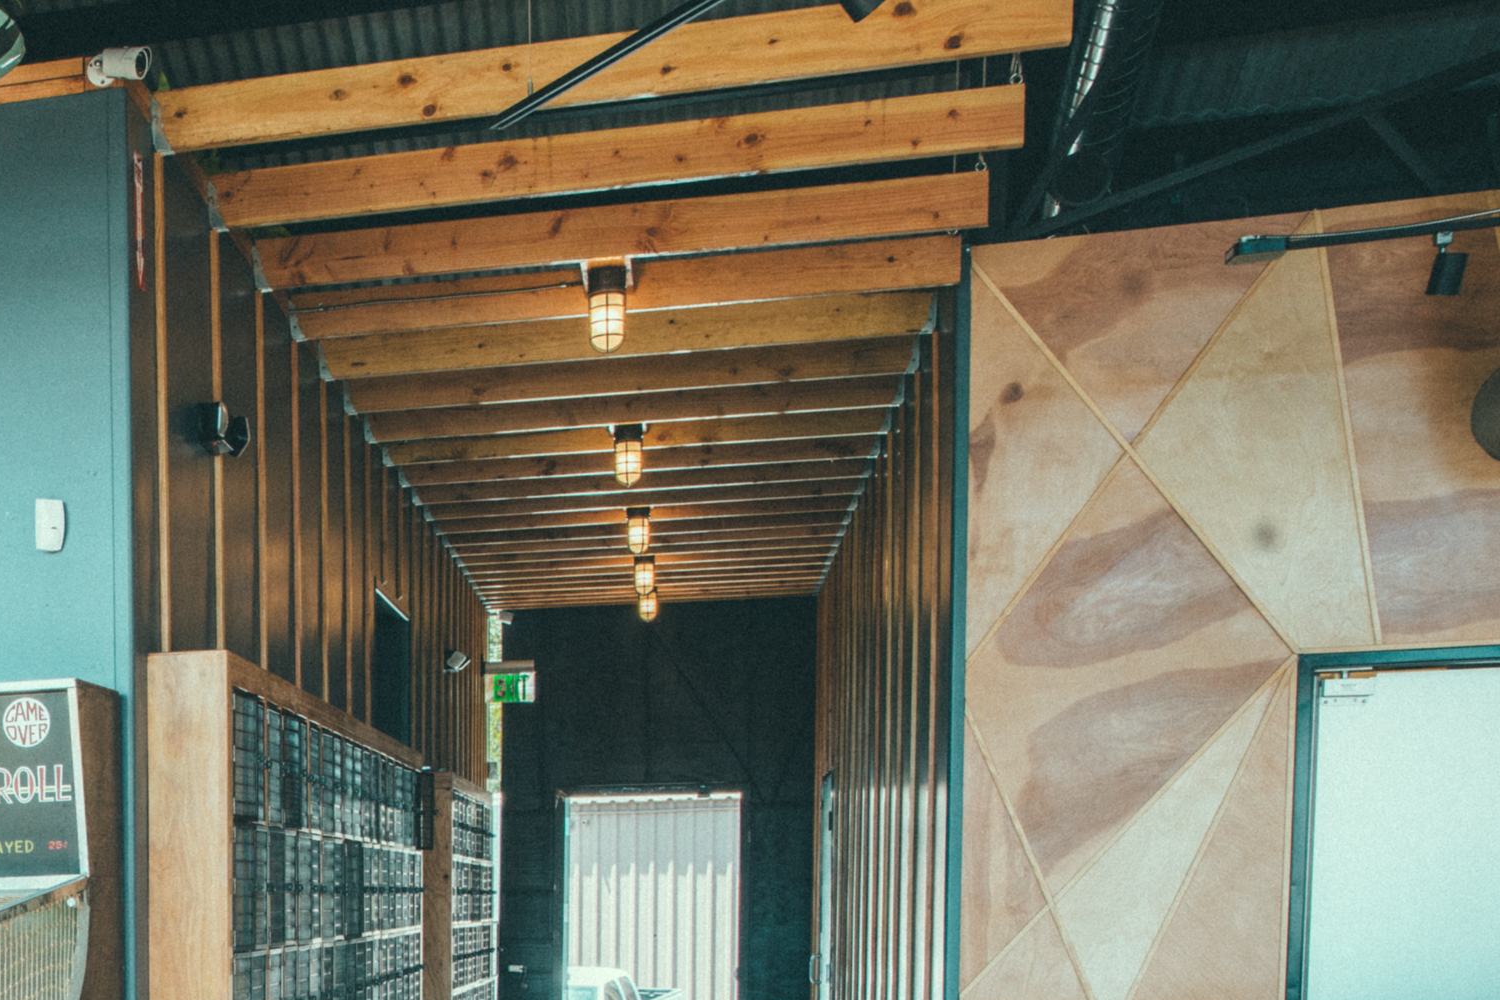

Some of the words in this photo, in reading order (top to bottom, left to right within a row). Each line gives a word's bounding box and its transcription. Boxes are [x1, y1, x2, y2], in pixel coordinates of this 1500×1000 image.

[493, 674, 529, 702] EXIT
[5, 700, 48, 723] GAME
[5, 723, 48, 746] OVER
